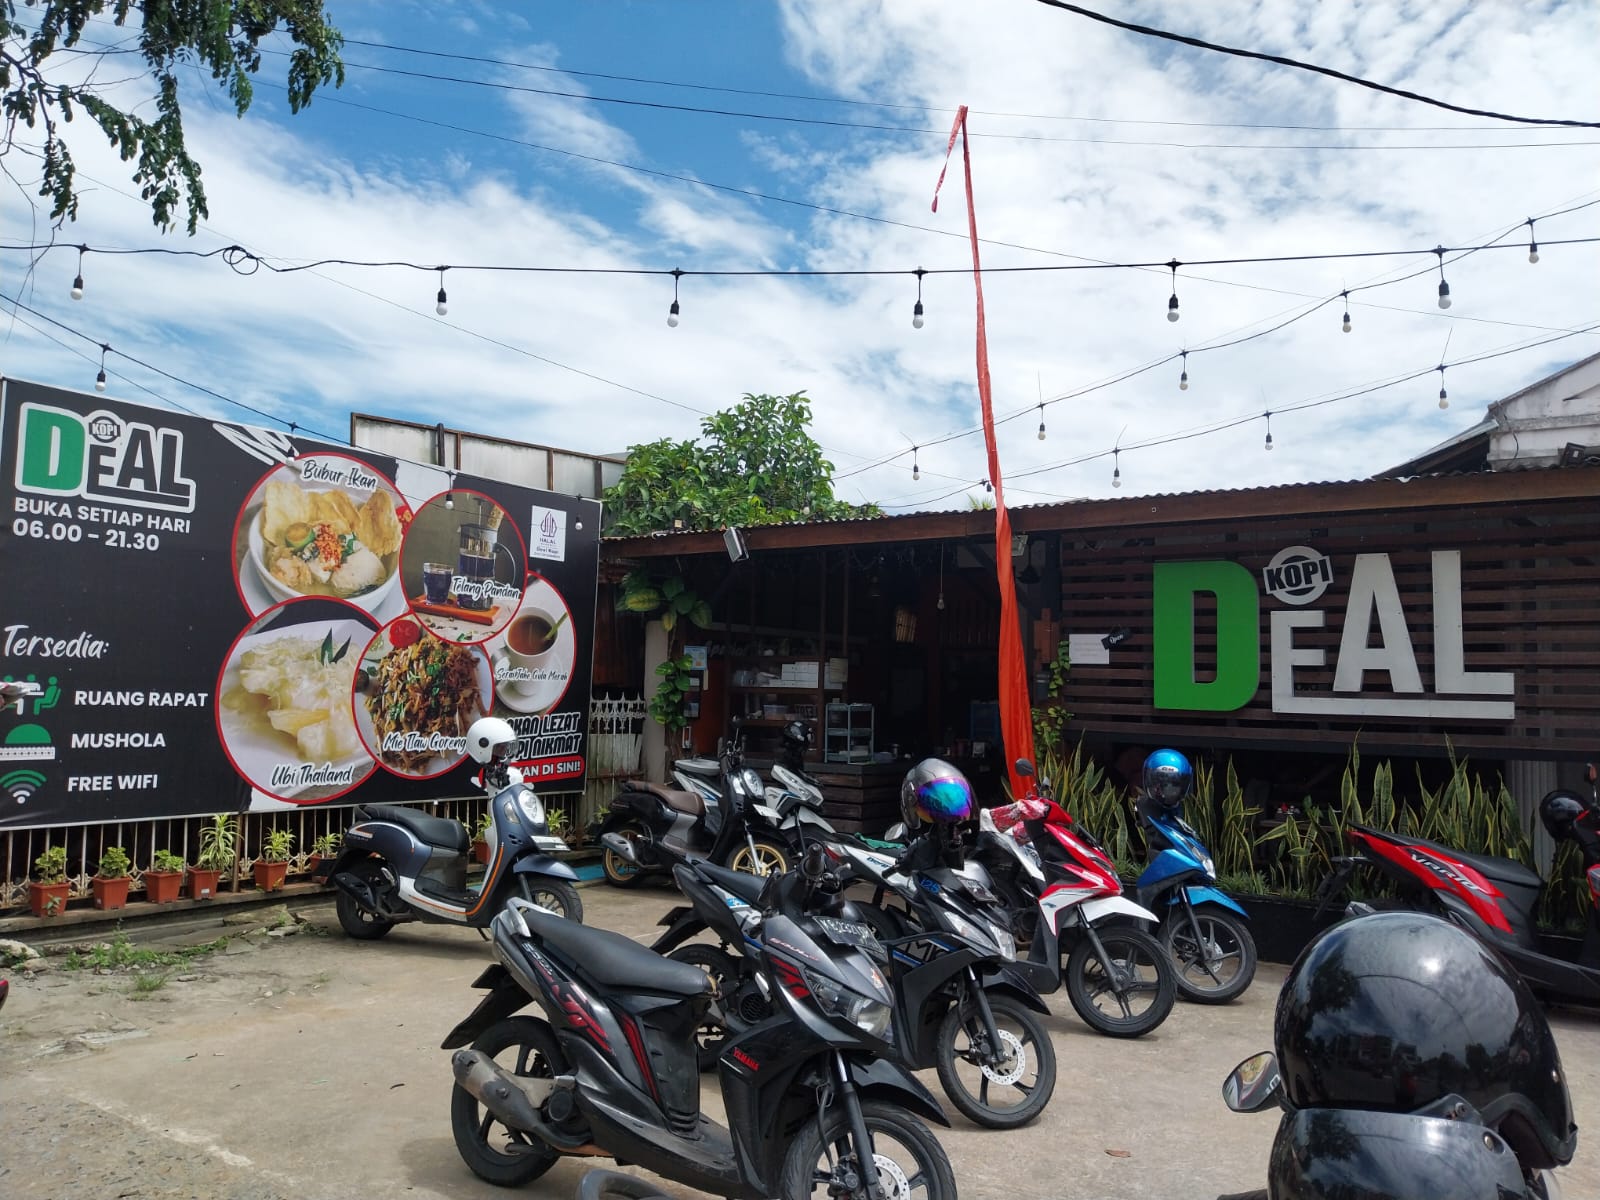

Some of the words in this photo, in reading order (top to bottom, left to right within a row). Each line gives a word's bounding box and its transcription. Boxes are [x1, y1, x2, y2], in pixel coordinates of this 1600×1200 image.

[92, 421, 120, 437] KOPI
[17, 404, 195, 510] DEAL
[302, 458, 342, 483] Bubur
[347, 466, 377, 489] Ikan
[15, 497, 72, 519] BUKA
[77, 505, 144, 527] SETIAP
[147, 514, 191, 533] HARI
[13, 518, 82, 542] 06.00
[105, 529, 159, 551] 21.30
[1265, 557, 1332, 591] KOPI
[452, 577, 482, 600] Telang
[482, 580, 520, 600] Pandan
[1153, 550, 1515, 719] DEAL
[548, 670, 568, 681] Merah
[74, 690, 145, 707] RUANG
[148, 691, 208, 708] RAPAT
[541, 712, 580, 735] LEZAT
[71, 732, 166, 749] MUSHOLA
[383, 731, 404, 751] Mie
[429, 731, 467, 755] Goreng
[531, 733, 582, 758] NIKMAT
[270, 764, 296, 787] Ubi
[297, 763, 354, 786] Thailand
[542, 764, 554, 775] DI
[556, 761, 580, 773] SINI!
[68, 775, 112, 792] FREE
[118, 774, 158, 790] WIFI
[733, 1047, 759, 1071] YAMAHA
